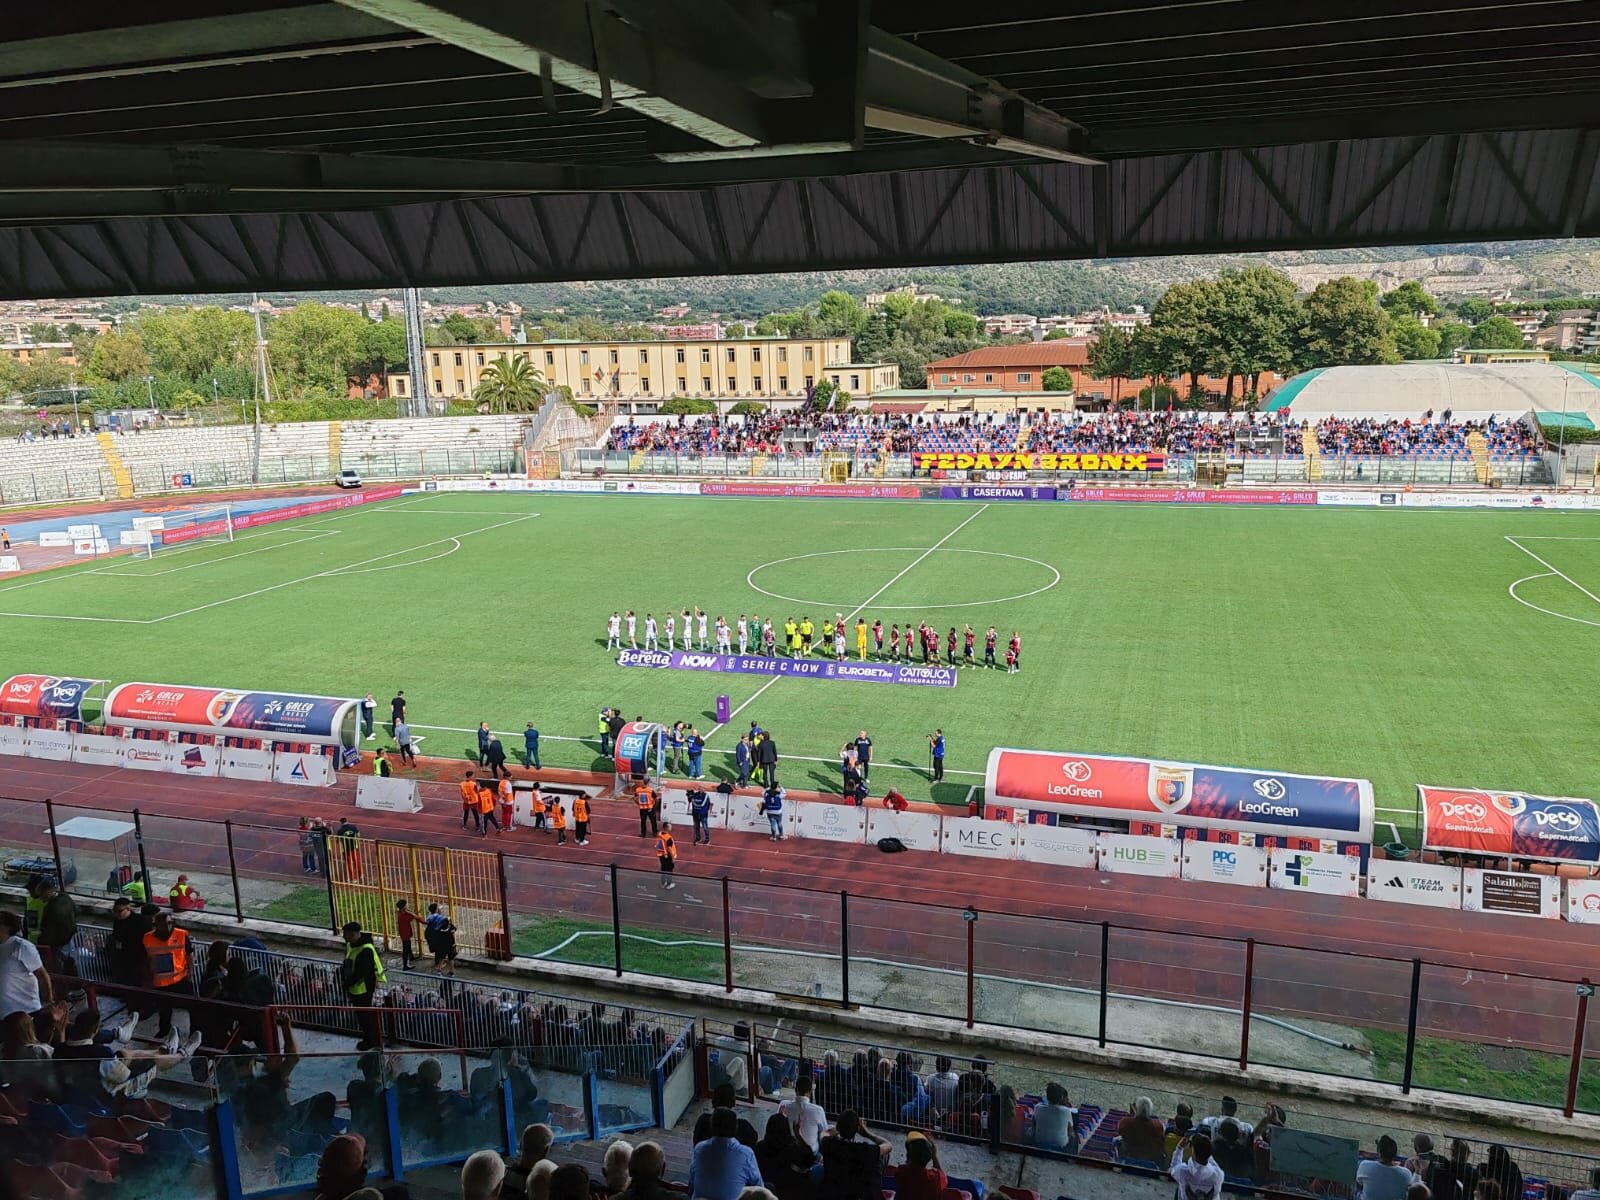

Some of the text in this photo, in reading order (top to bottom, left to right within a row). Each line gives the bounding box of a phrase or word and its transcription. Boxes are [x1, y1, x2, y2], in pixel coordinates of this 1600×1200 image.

[1041, 453, 1147, 470] BRONX
[973, 488, 1024, 497] CASERTANA
[619, 650, 670, 665] Beretta
[680, 654, 717, 668] NOW
[742, 659, 776, 671] SERIE
[780, 662, 788, 671] C
[793, 663, 820, 673] NOW
[899, 667, 951, 679] CATTOLICA
[156, 691, 185, 700] GALEO
[285, 701, 315, 712] GALEO
[624, 736, 643, 747] PPG
[1048, 782, 1102, 799] LeoGreen
[1239, 800, 1299, 817] LeoGreen
[959, 829, 1003, 846] MEC
[1114, 847, 1147, 861] HUB
[1213, 850, 1236, 865] PPG
[1484, 875, 1522, 888] Salzillo
